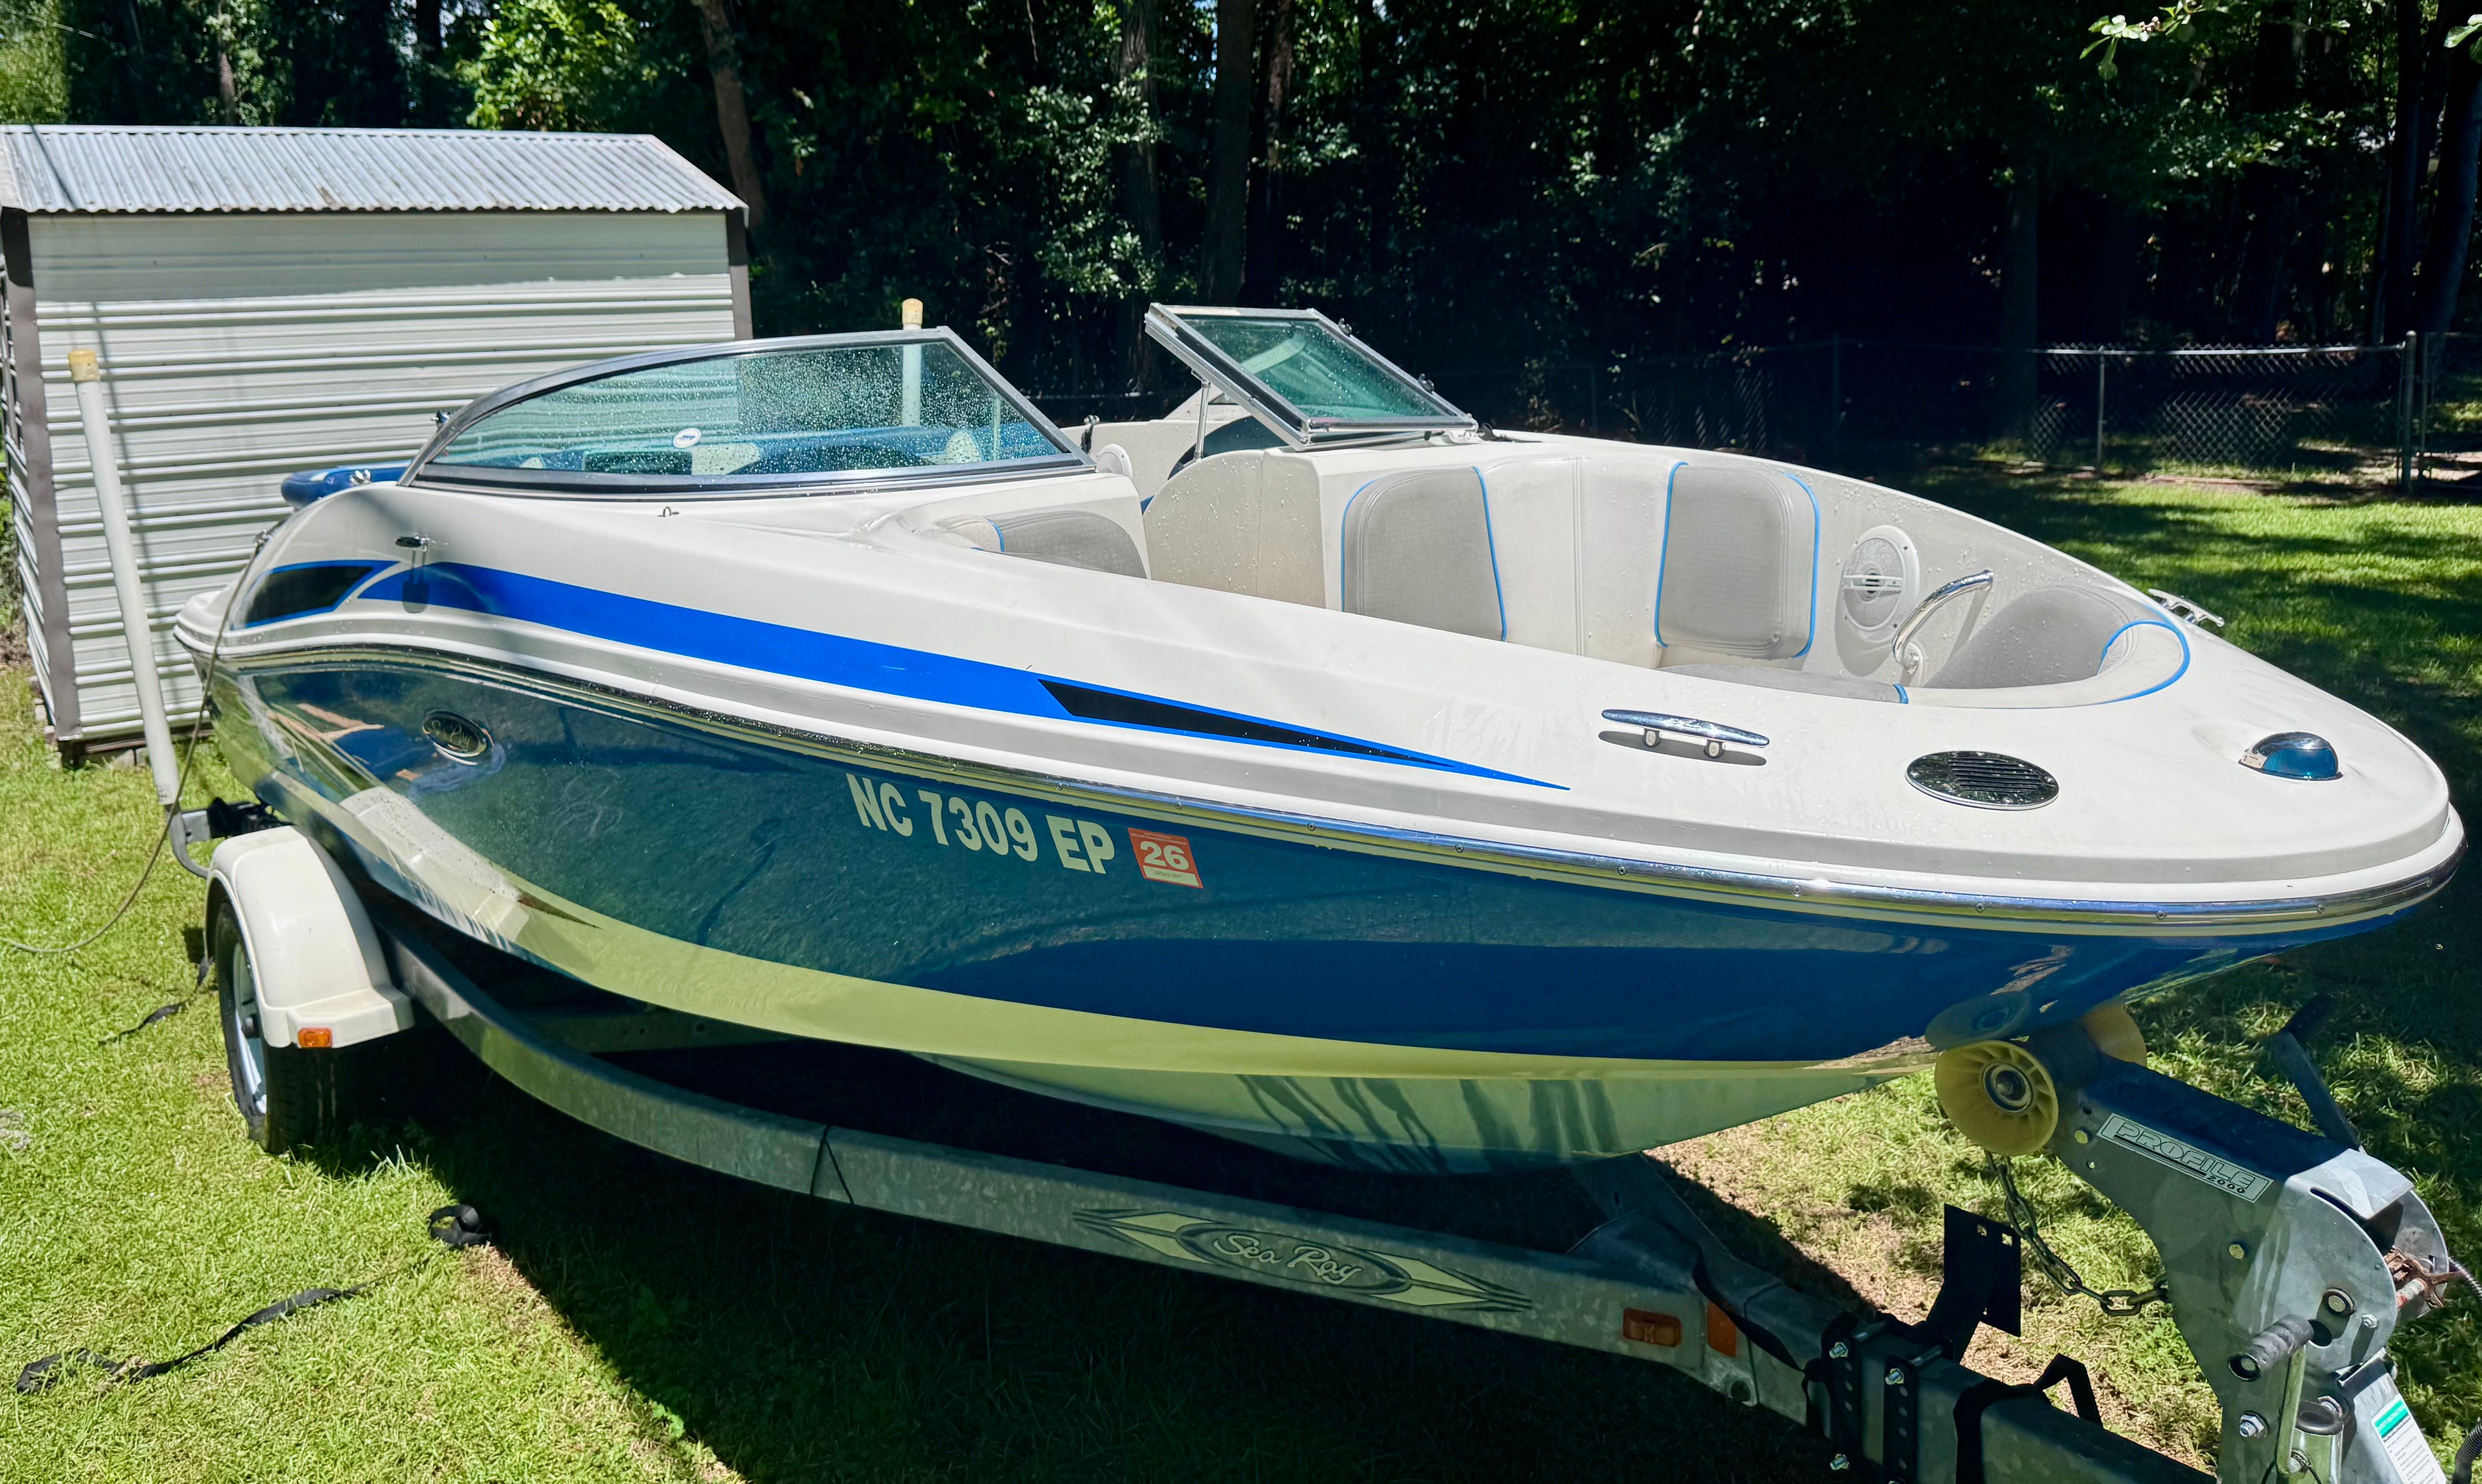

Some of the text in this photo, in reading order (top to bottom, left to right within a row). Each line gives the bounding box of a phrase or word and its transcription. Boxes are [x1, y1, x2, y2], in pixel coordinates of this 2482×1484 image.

[846, 773, 1115, 874] NC 7309 EP
[1140, 841, 1189, 870] 26
[2117, 1122, 2256, 1189] PROFILE
[2207, 1176, 2245, 1193] 2000
[1213, 1234, 1362, 1284] Sea Ray
